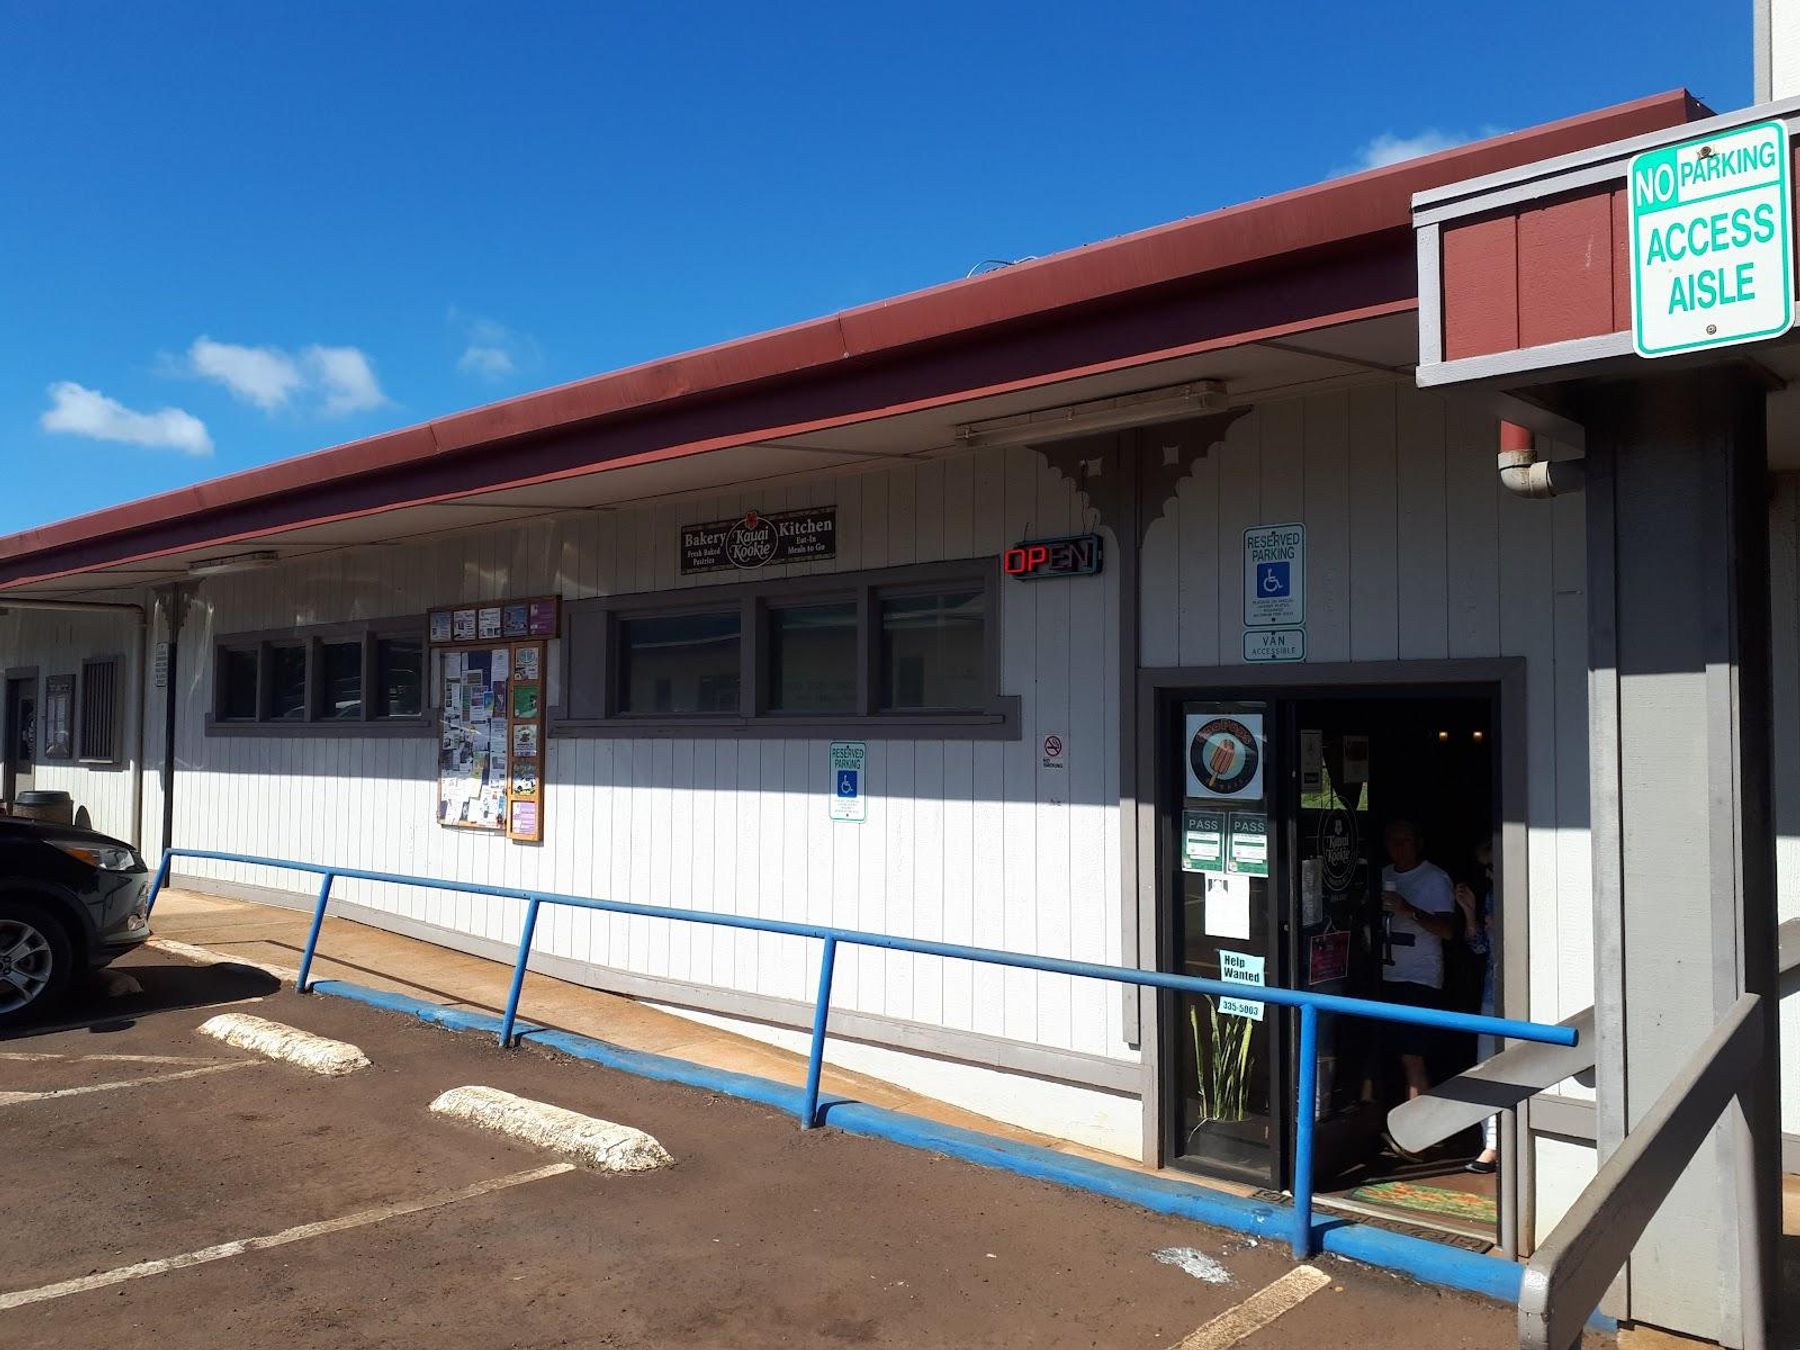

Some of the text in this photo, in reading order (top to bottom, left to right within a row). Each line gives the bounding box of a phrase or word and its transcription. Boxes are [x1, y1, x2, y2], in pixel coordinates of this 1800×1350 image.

[1636, 141, 1776, 206] NO PARKING
[1647, 203, 1775, 265] ACCESS
[1668, 262, 1755, 314] AISLE
[779, 519, 833, 536] Kitchen
[685, 532, 727, 547] Bakery
[732, 526, 769, 546] Kauai
[1247, 533, 1300, 549] RESERVED
[687, 547, 721, 558] Fresh Baked
[731, 541, 771, 562] Kookie
[1005, 542, 1089, 574] OPEN
[1252, 547, 1295, 562] PARKING
[1262, 636, 1285, 646] VAN
[1252, 647, 1296, 656] ACCESSIBLE
[832, 748, 864, 759] RESERVED
[834, 759, 861, 769] PARKING
[1189, 819, 1218, 830] PASS
[1234, 821, 1265, 832] PASS
[1224, 955, 1245, 968] Help
[1224, 967, 1260, 983] Wanted
[1223, 1001, 1259, 1016] 335-5003
